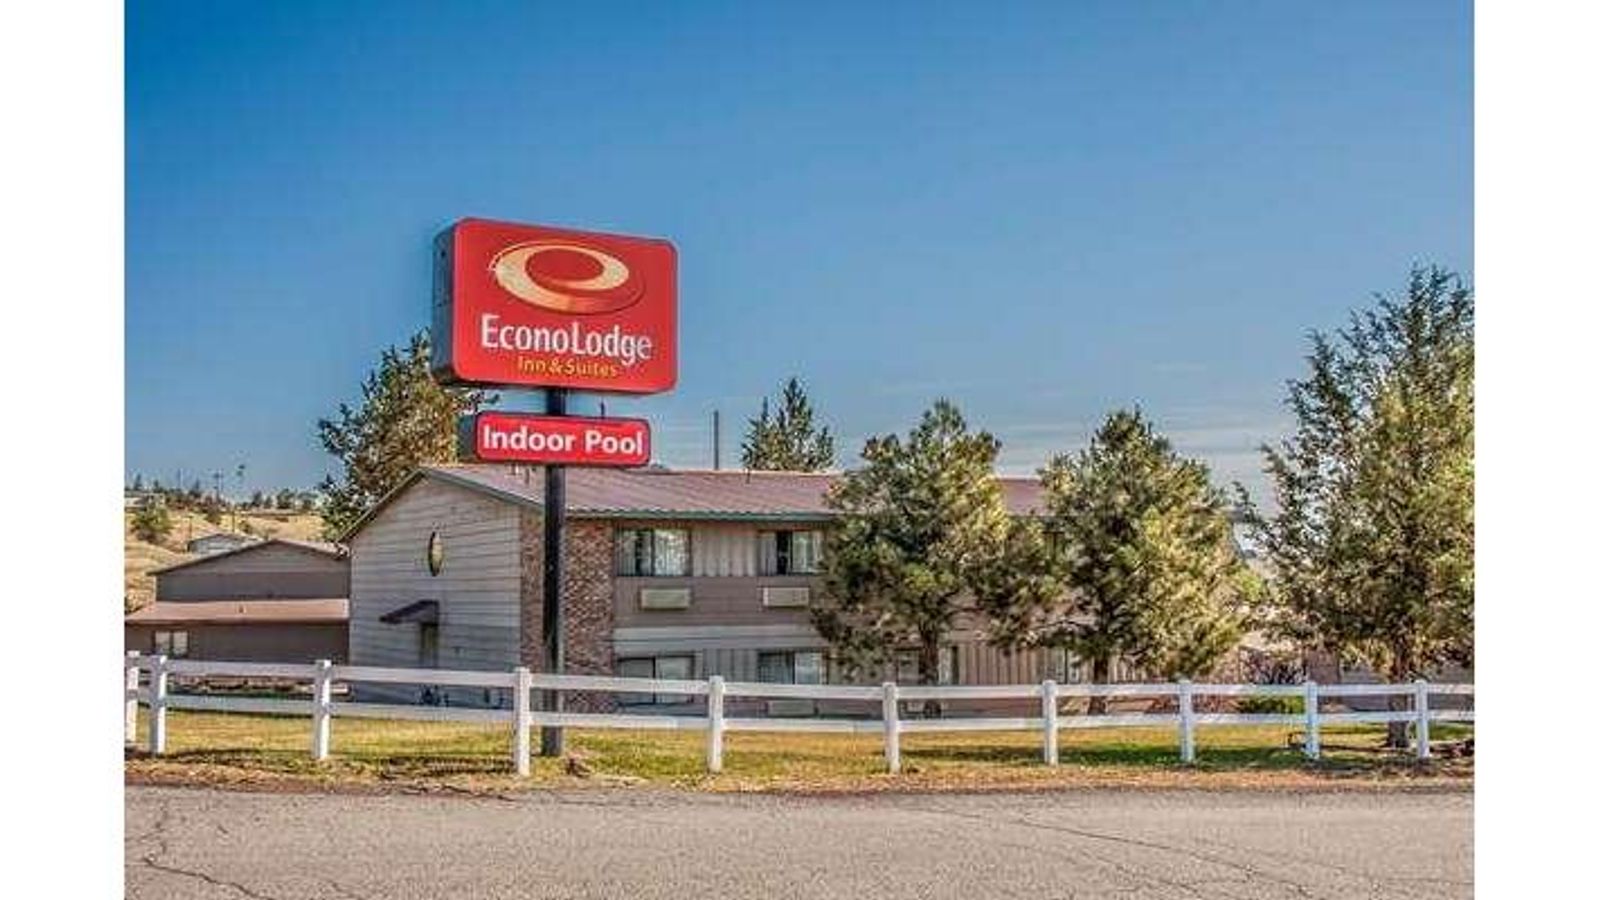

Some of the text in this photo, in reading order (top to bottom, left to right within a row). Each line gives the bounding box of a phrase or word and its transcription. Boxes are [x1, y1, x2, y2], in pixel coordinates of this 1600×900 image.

[517, 356, 546, 373] Inn
[483, 426, 643, 455] Indoor Pool
